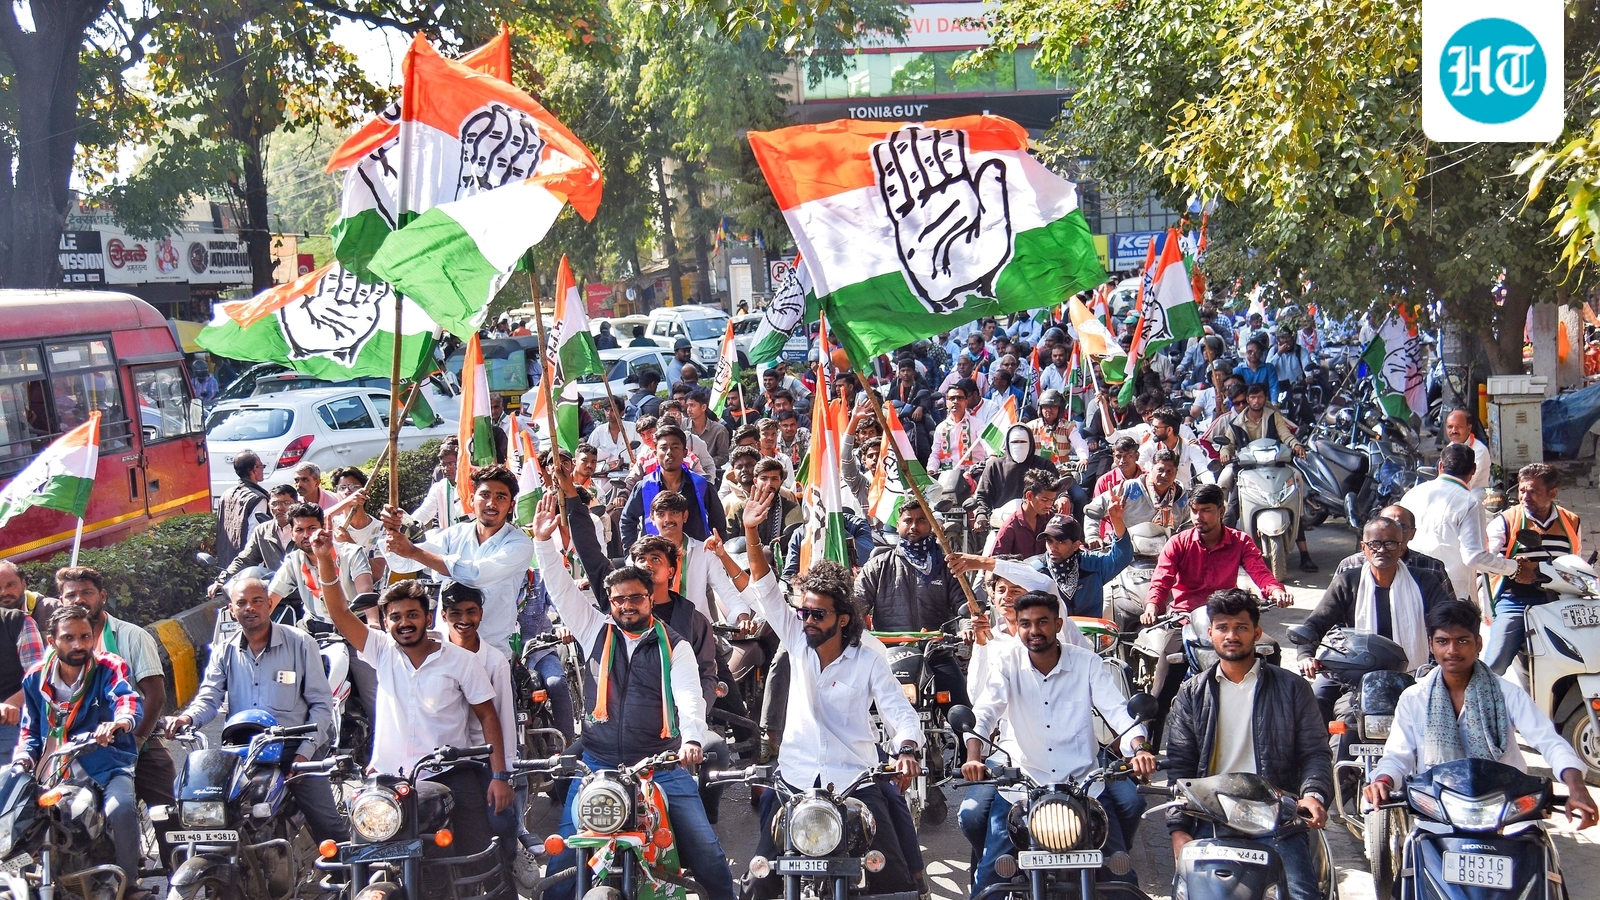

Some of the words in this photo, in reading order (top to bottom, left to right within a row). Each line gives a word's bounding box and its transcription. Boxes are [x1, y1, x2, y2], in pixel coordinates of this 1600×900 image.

[209, 241, 238, 250] NAGPUR
[1117, 233, 1159, 249] KEI
[211, 252, 249, 267] AQUARIU
[582, 806, 621, 815] BOSS
[173, 834, 186, 842] MH
[206, 833, 212, 841] K
[788, 860, 801, 870] MH
[1032, 856, 1044, 865] MH
[1076, 853, 1099, 863] 7171
[1458, 854, 1504, 872] MH31G
[1458, 868, 1504, 886] B9652
